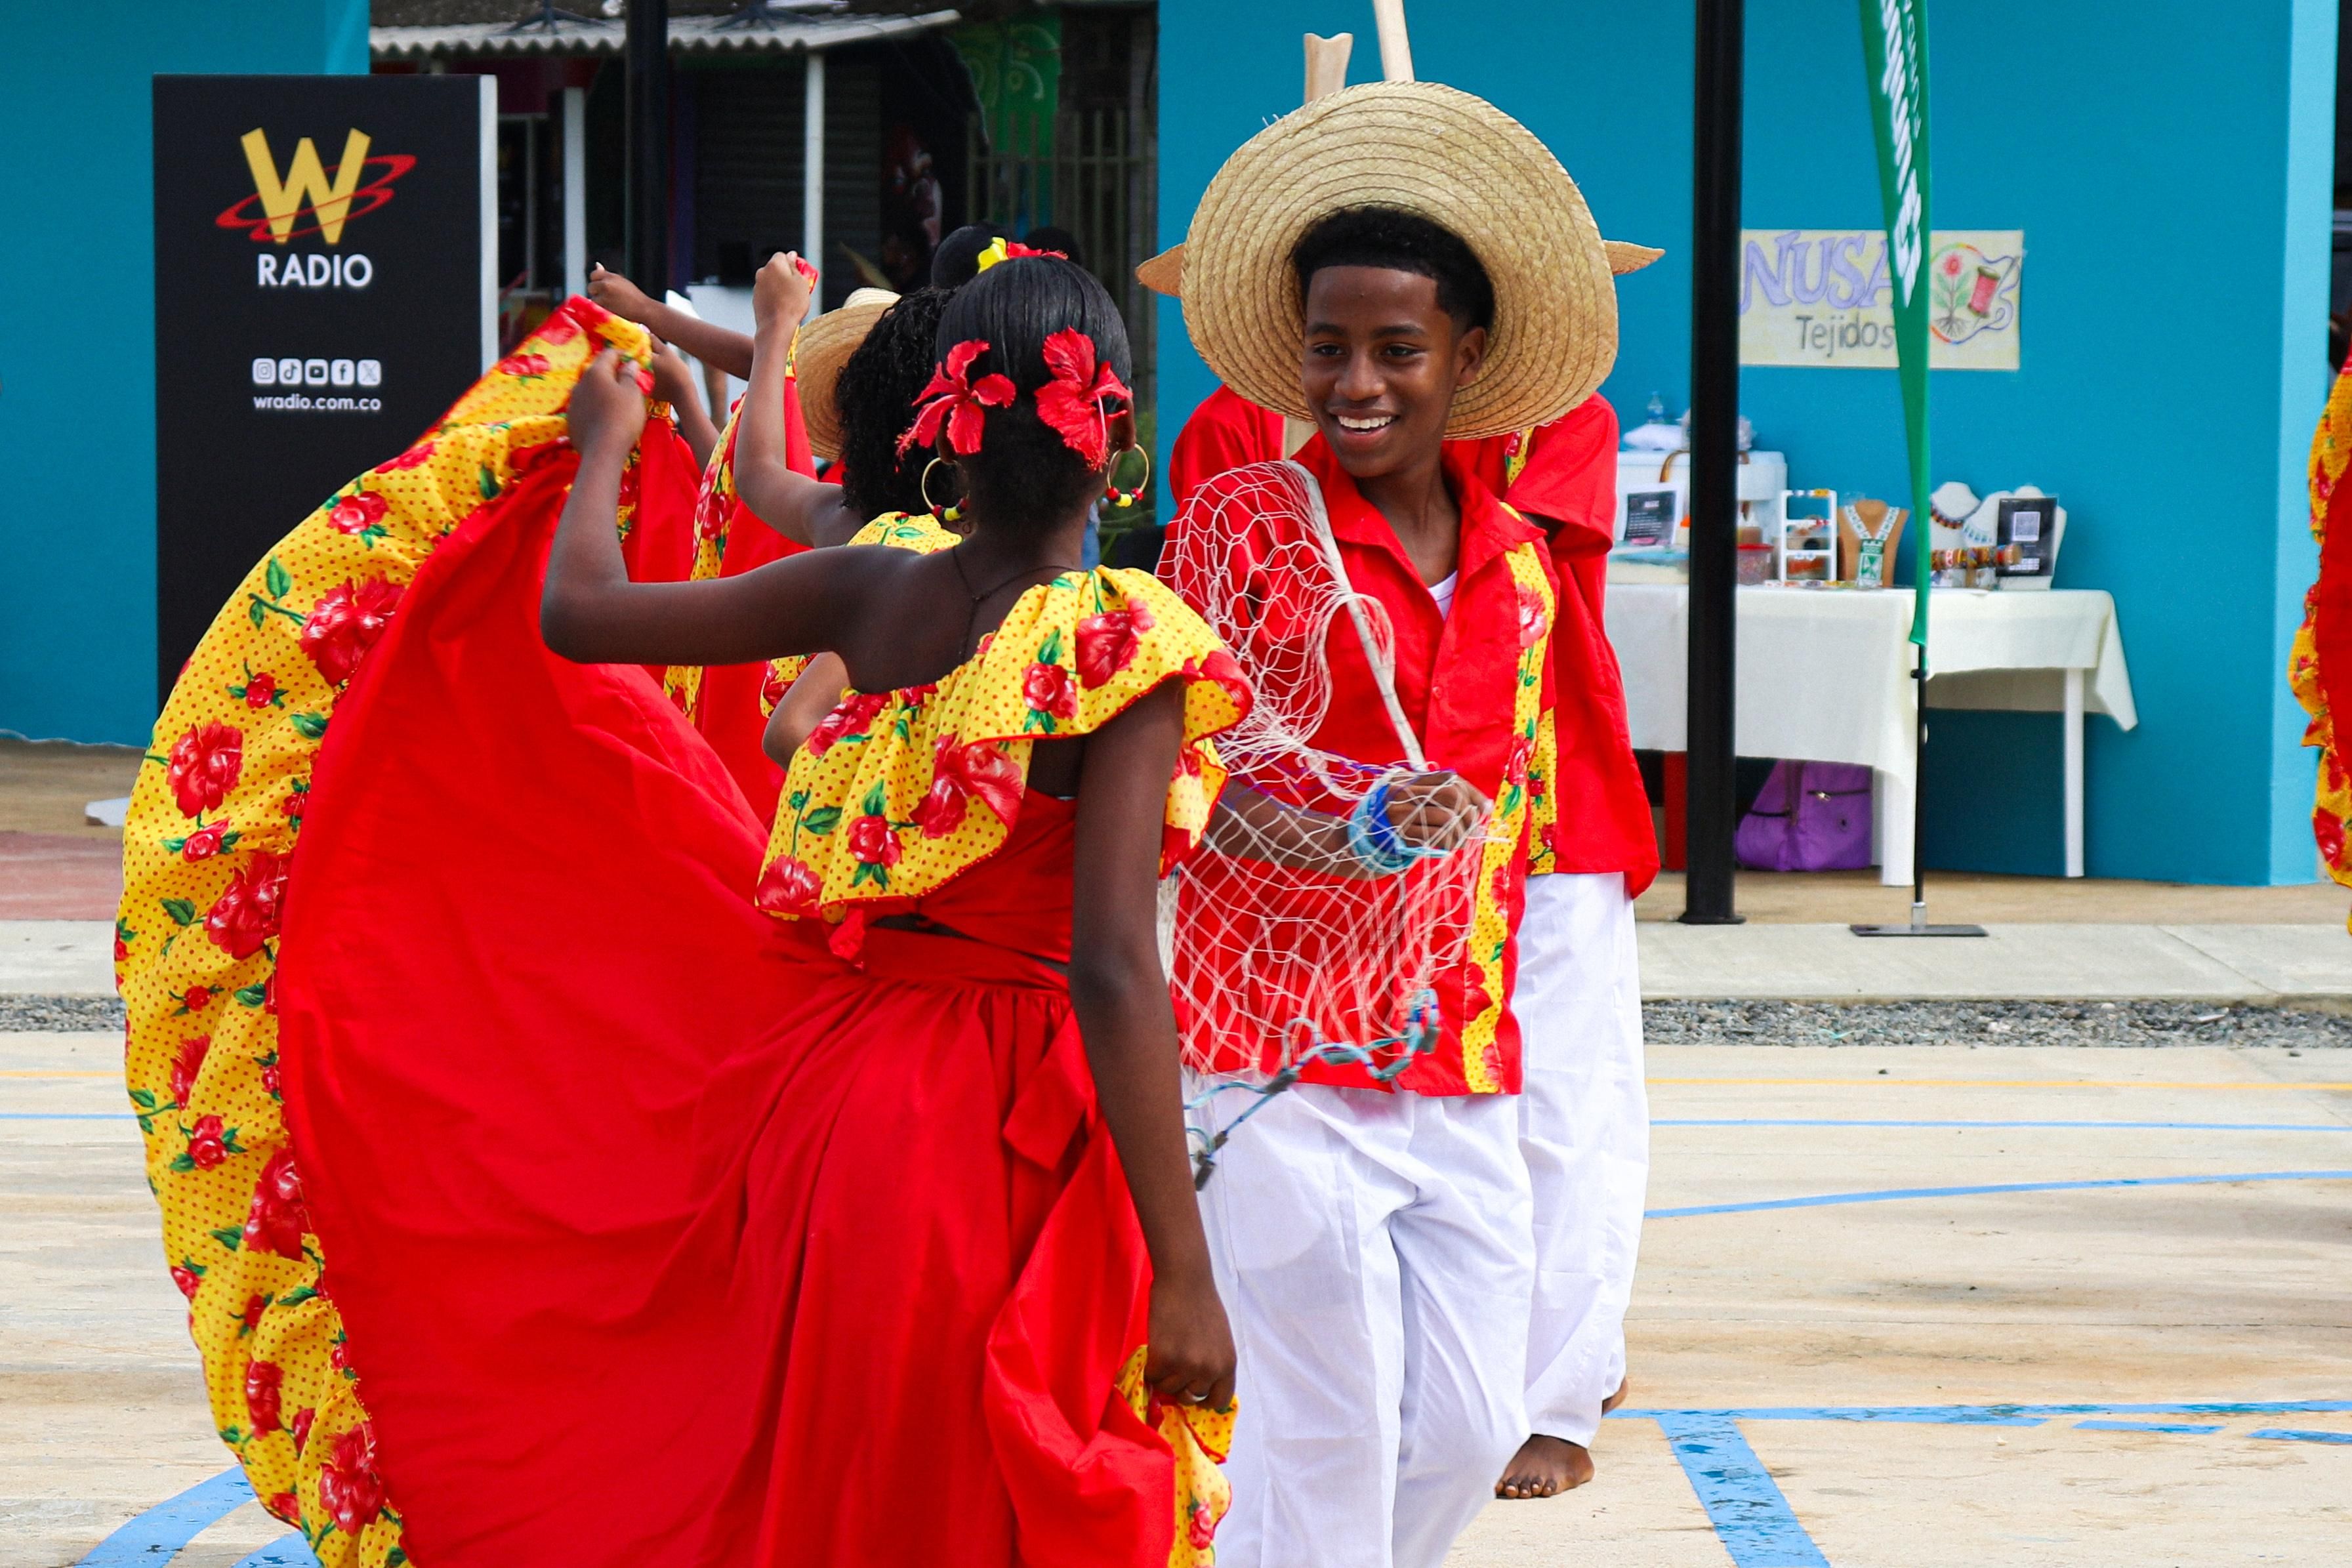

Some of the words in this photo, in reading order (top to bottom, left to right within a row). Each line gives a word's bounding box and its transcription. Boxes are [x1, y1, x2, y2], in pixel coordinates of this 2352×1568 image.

[240, 127, 372, 245] W
[257, 253, 373, 287] RADIO
[1795, 312, 1895, 358] Tejidos
[253, 394, 381, 411] wradio.com.co
